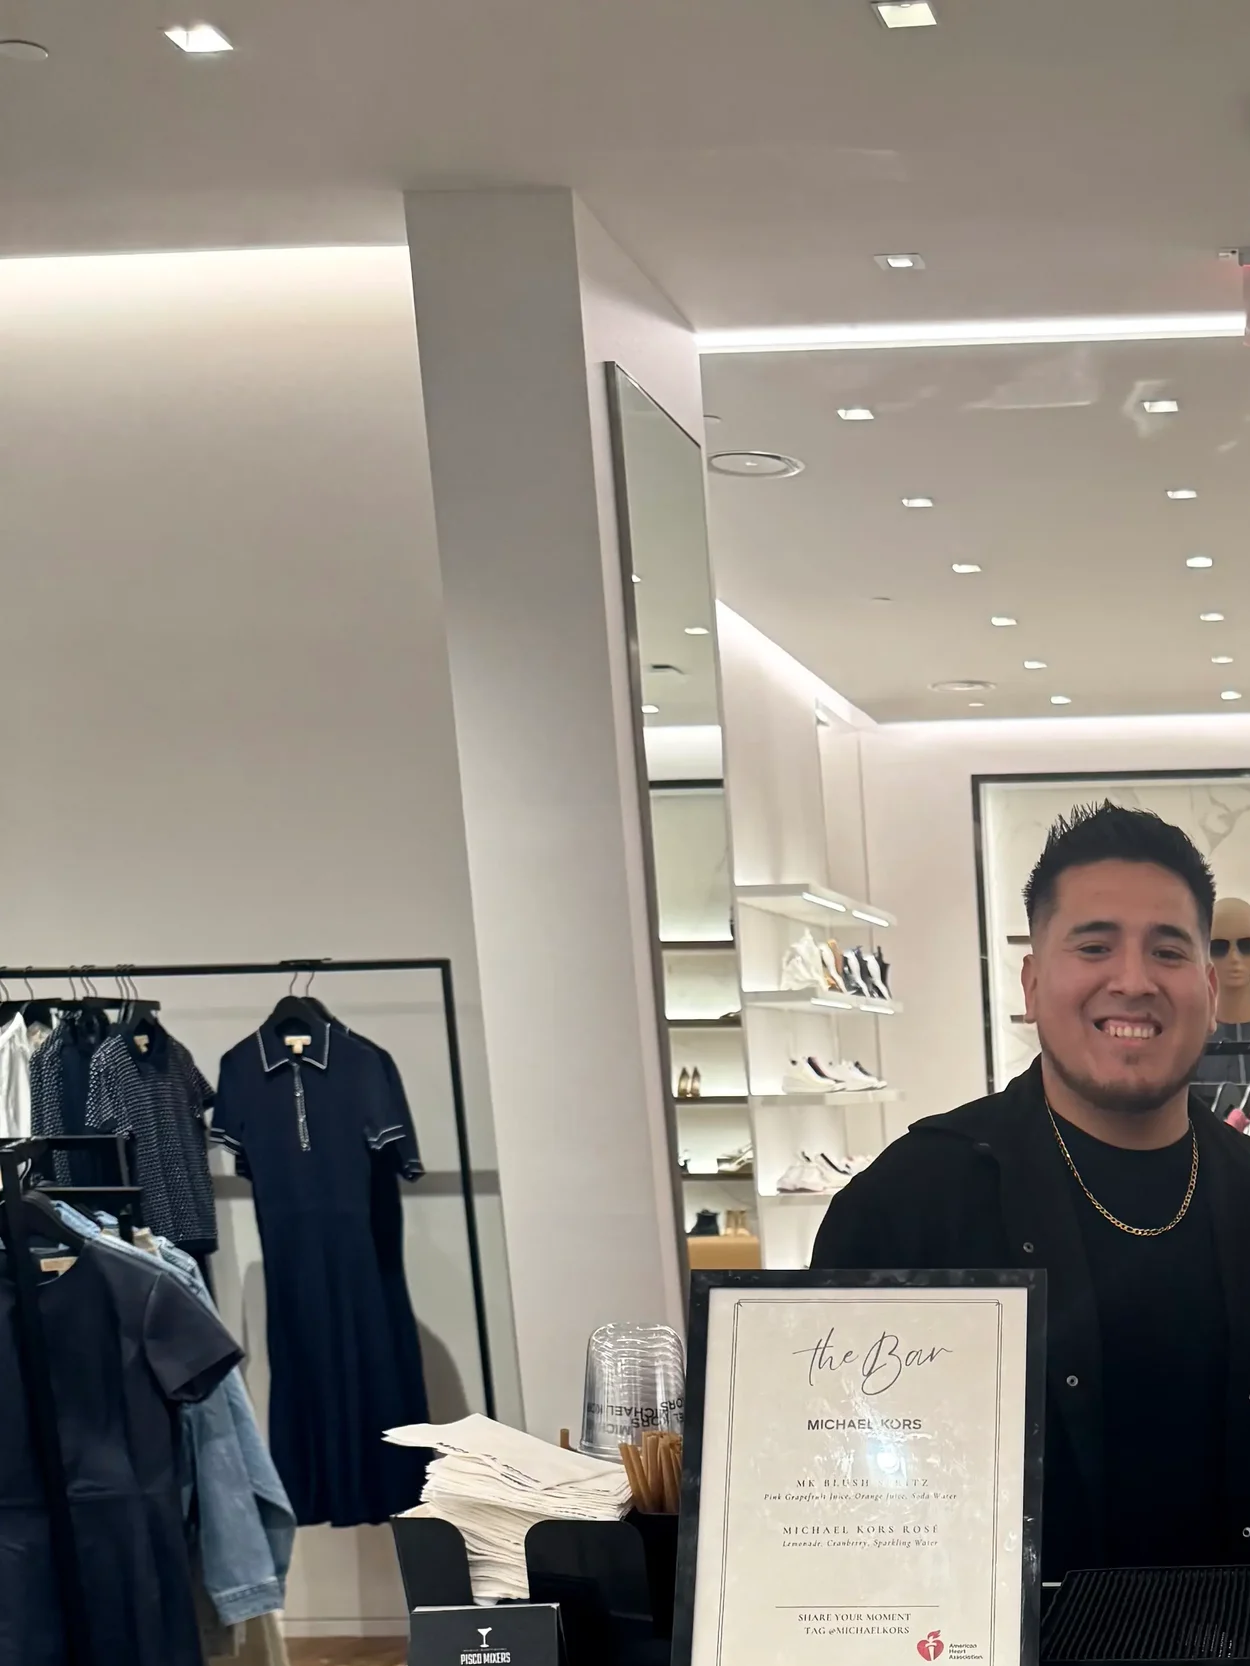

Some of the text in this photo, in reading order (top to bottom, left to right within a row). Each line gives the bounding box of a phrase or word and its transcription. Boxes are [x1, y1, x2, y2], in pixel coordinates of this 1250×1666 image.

[792, 1327, 953, 1396] the Bar
[807, 1418, 922, 1431] MICHAEL KORS
[796, 1479, 815, 1488] MK
[824, 1479, 869, 1488] BLUSH
[783, 1526, 849, 1535] MICHAEL
[857, 1525, 894, 1534] KORS
[873, 1539, 911, 1548] Sparkling
[798, 1612, 912, 1622] SHARE YOUR MOMENT
[804, 1626, 910, 1635] TAG @MICHAELKORS
[460, 1651, 511, 1666] PISCO MIXERS
